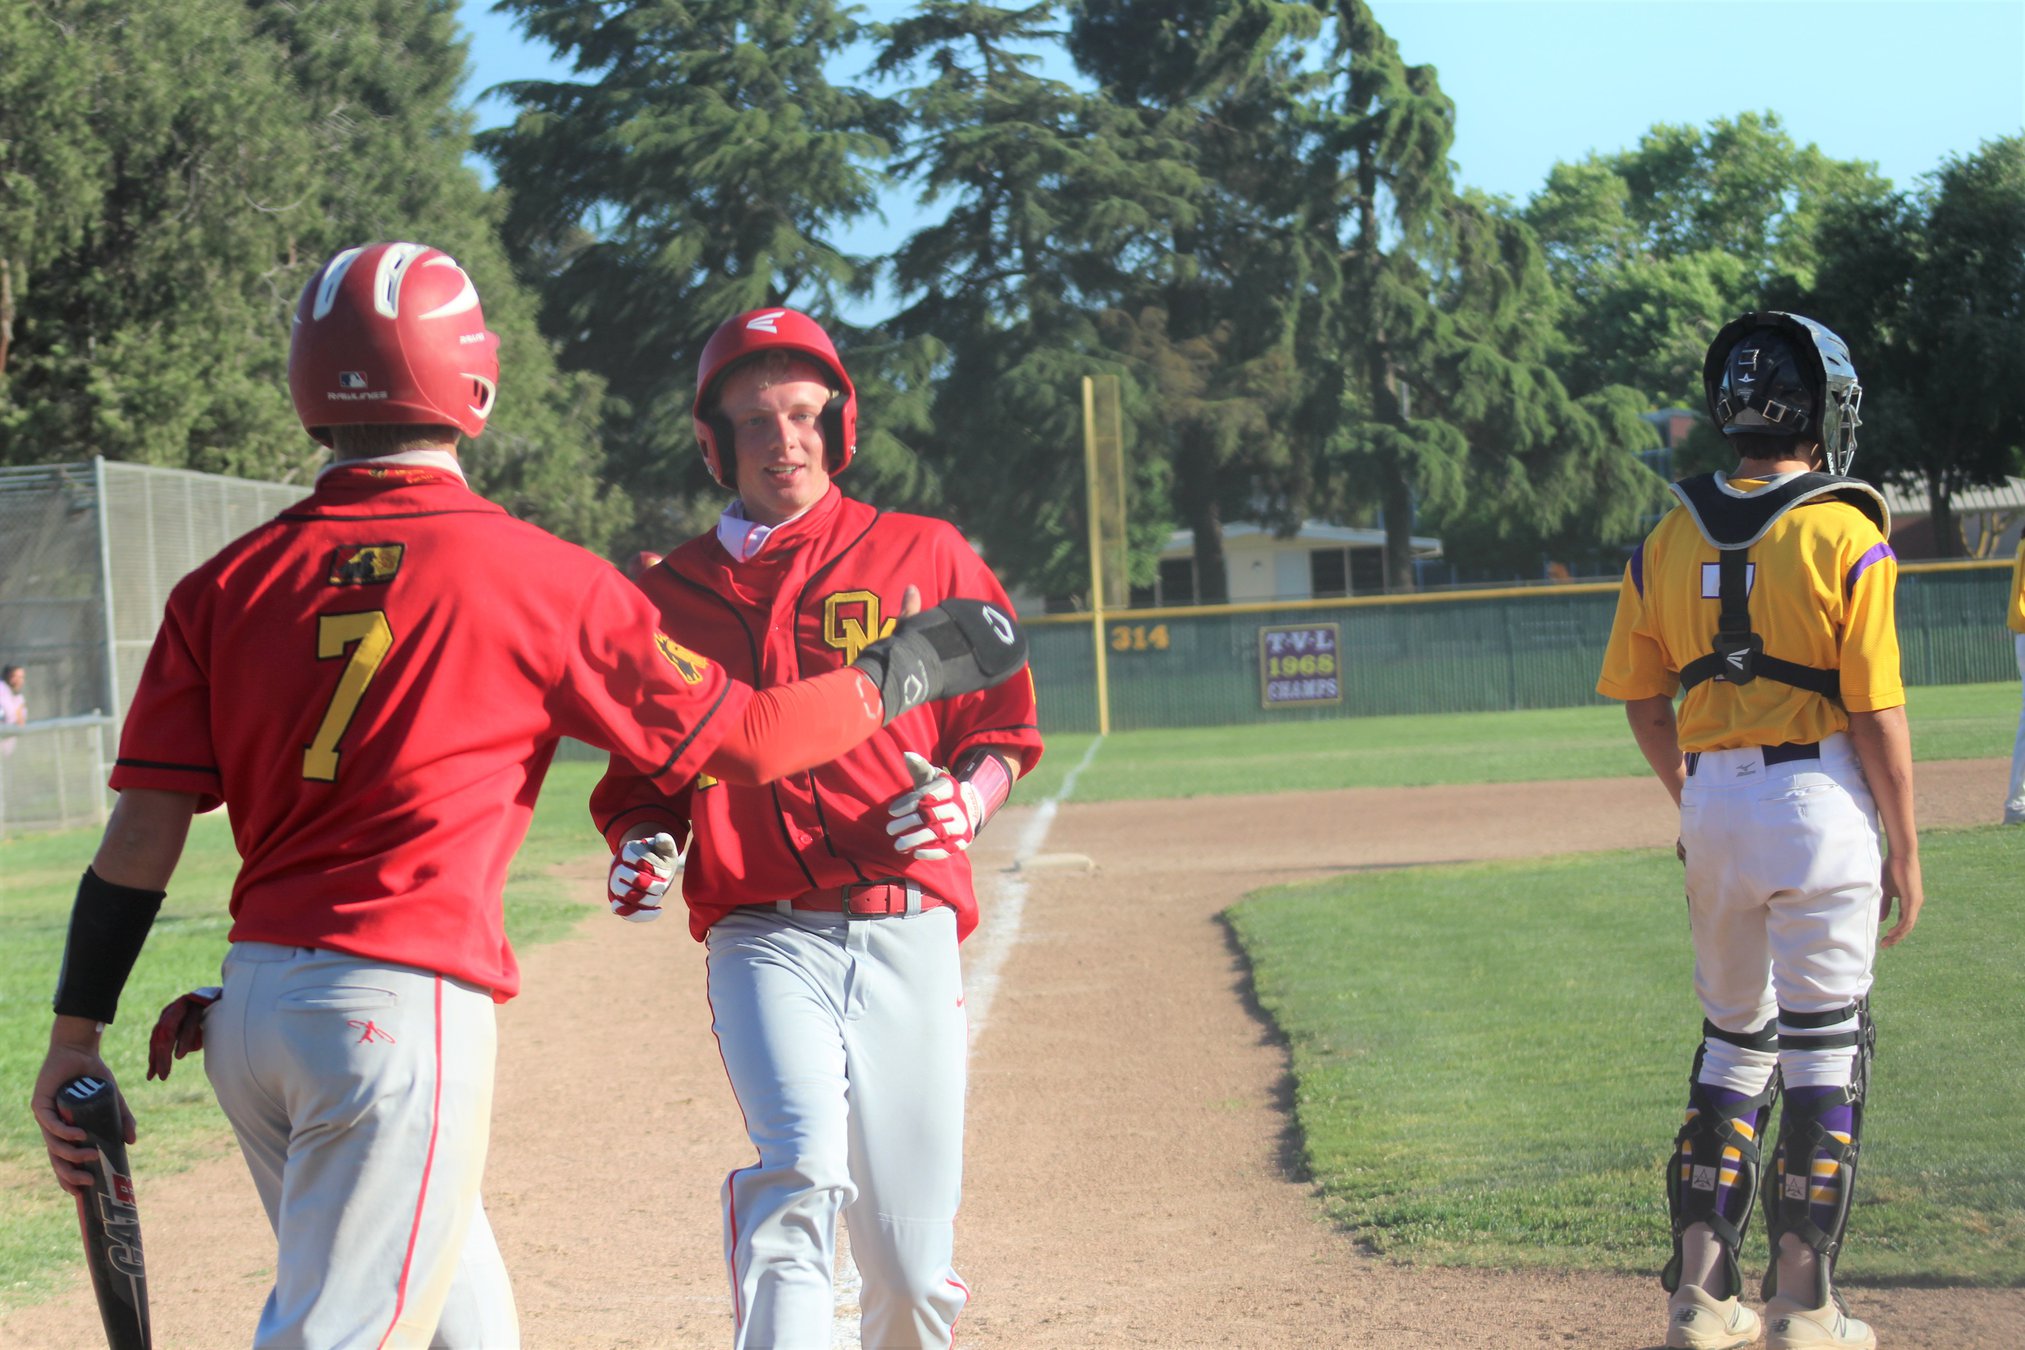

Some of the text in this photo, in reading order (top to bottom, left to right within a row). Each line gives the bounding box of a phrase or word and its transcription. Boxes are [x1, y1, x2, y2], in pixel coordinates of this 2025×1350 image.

[1112, 625, 1169, 650] 314
[302, 610, 394, 782] 7
[1268, 678, 1337, 701] CHAMPS
